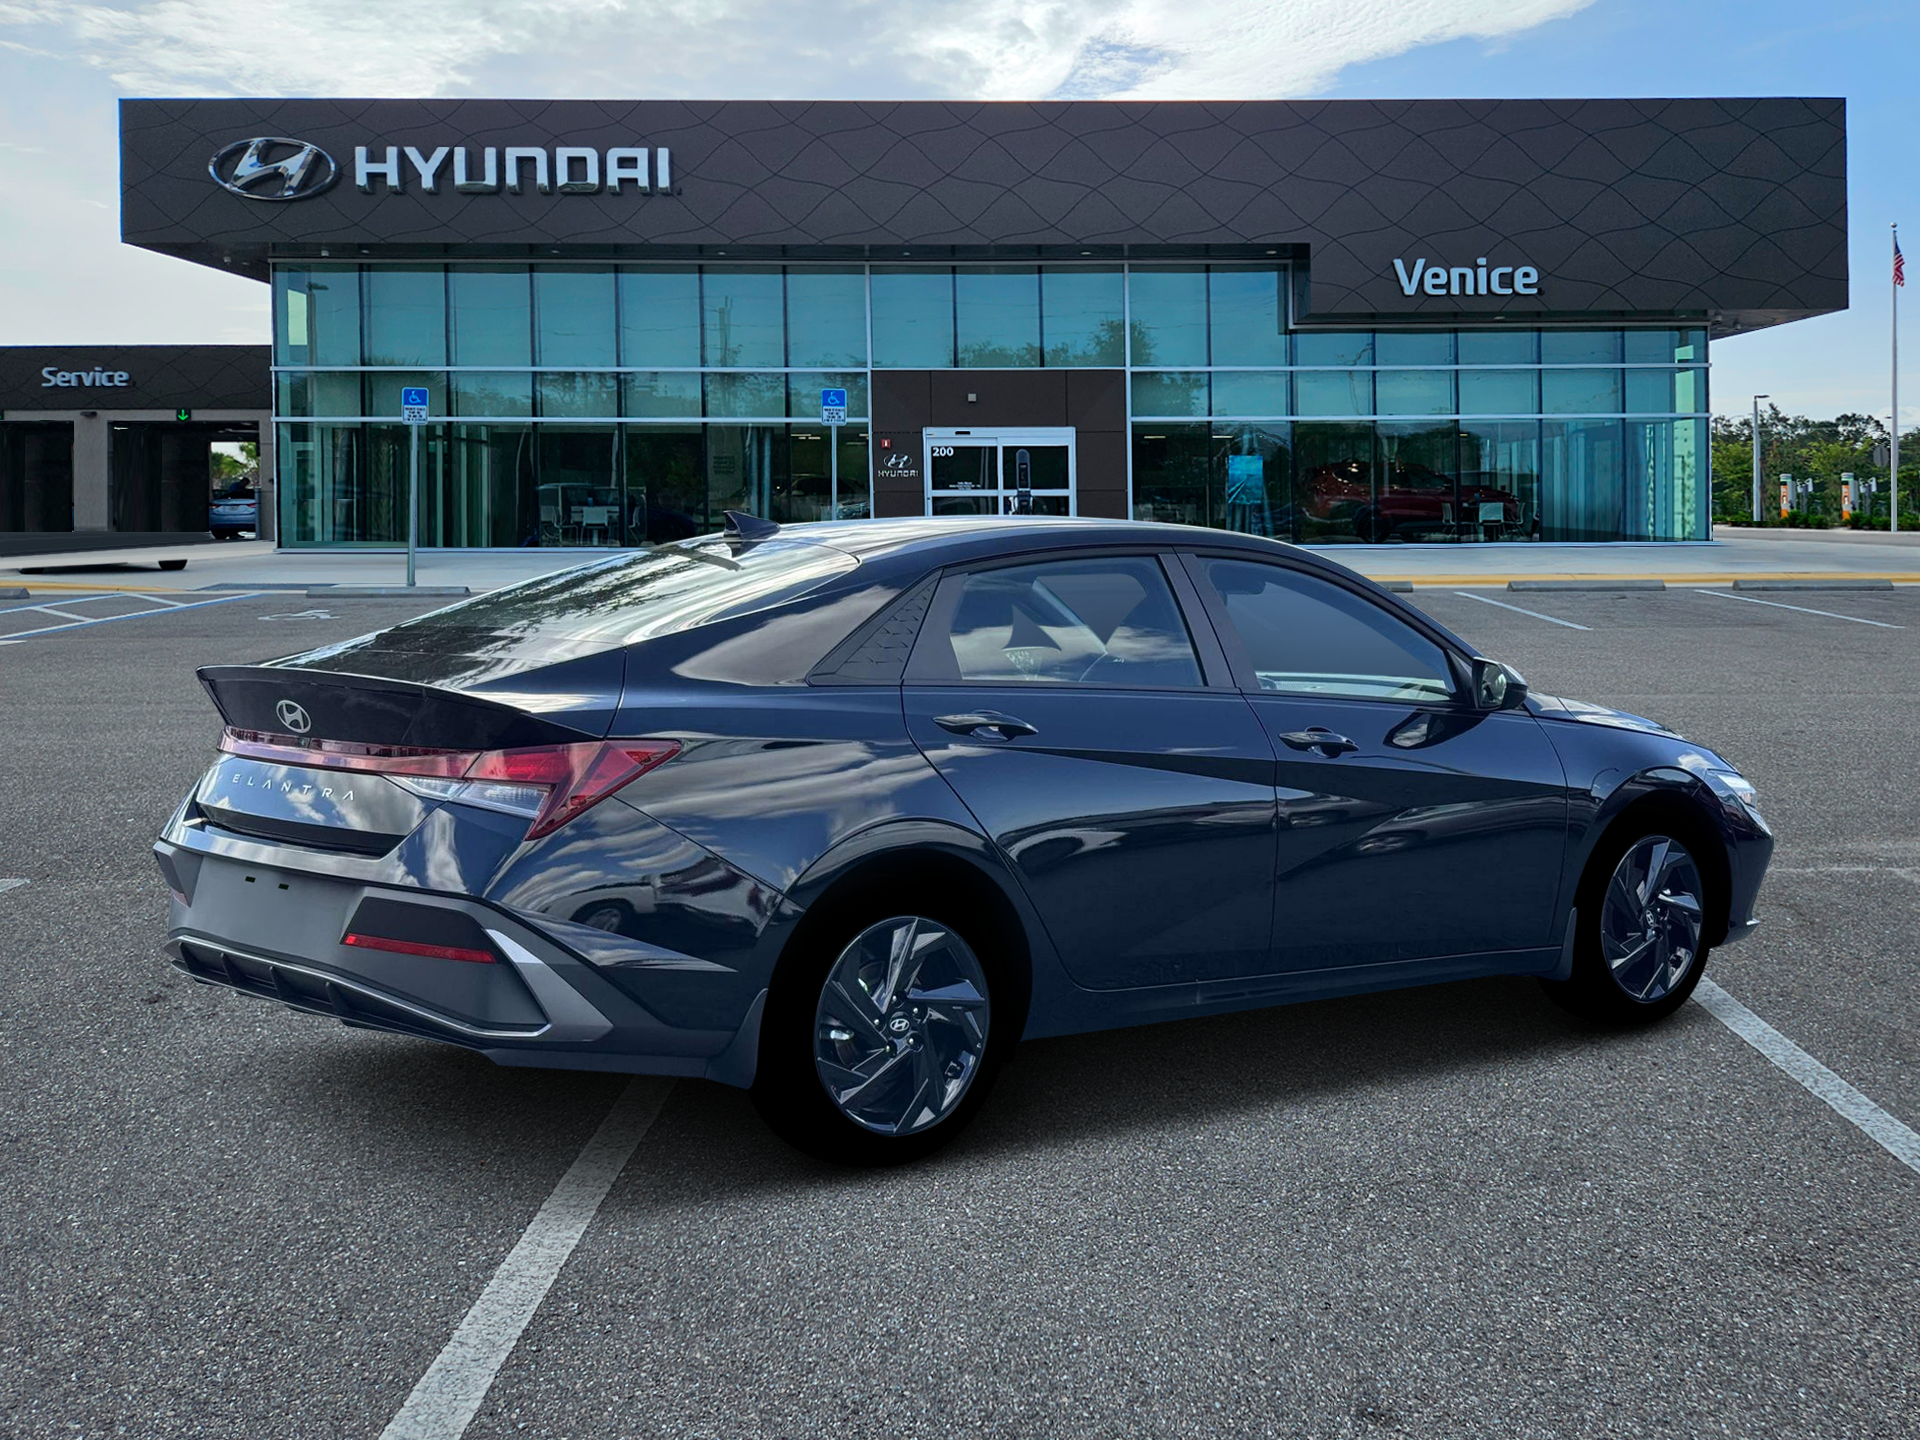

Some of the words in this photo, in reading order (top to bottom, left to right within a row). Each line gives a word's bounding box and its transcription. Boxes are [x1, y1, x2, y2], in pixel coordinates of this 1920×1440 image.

[355, 146, 671, 193] HYUNDAI
[1393, 257, 1539, 295] Venice
[41, 366, 130, 387] Service
[932, 446, 954, 457] 200
[878, 470, 919, 478] HYUNDAI
[232, 773, 355, 801] ELANTRA
